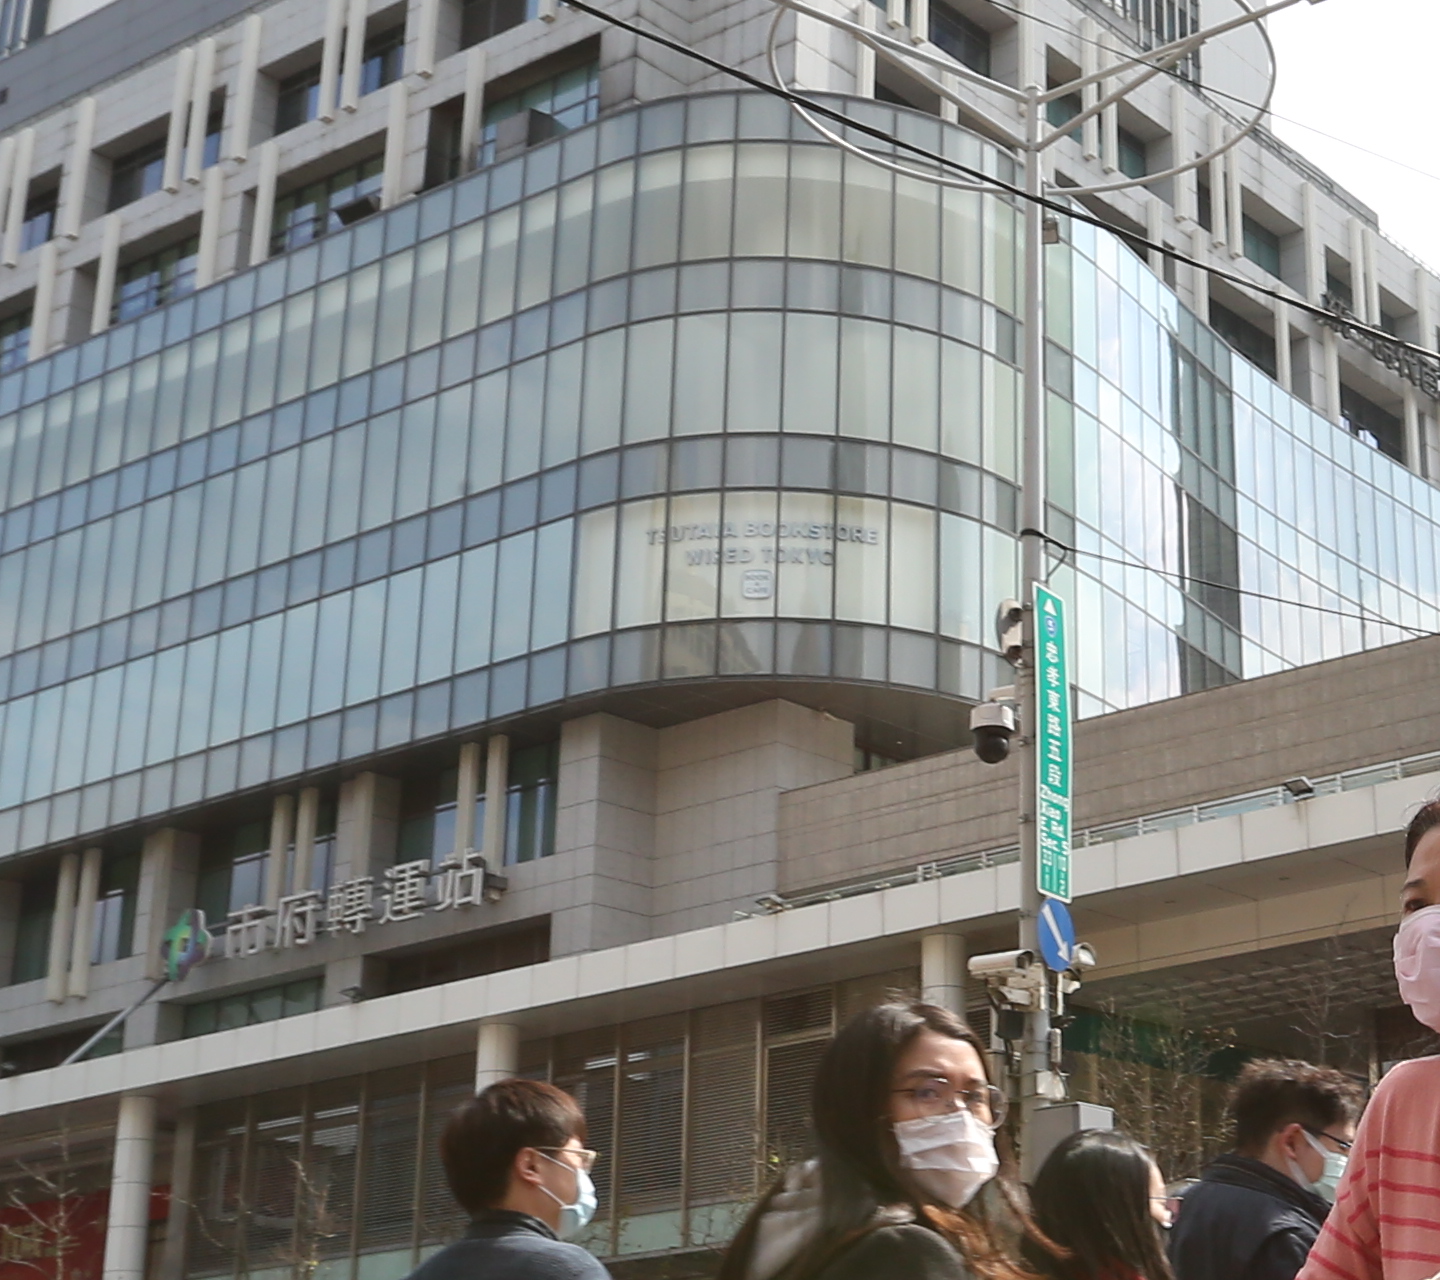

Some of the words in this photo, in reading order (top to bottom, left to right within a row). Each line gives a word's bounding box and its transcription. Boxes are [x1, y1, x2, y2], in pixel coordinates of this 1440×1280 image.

[743, 522, 879, 545] BOOKSTORE
[761, 548, 834, 566] TOKYO
[225, 847, 487, 959] 市府轉運站
